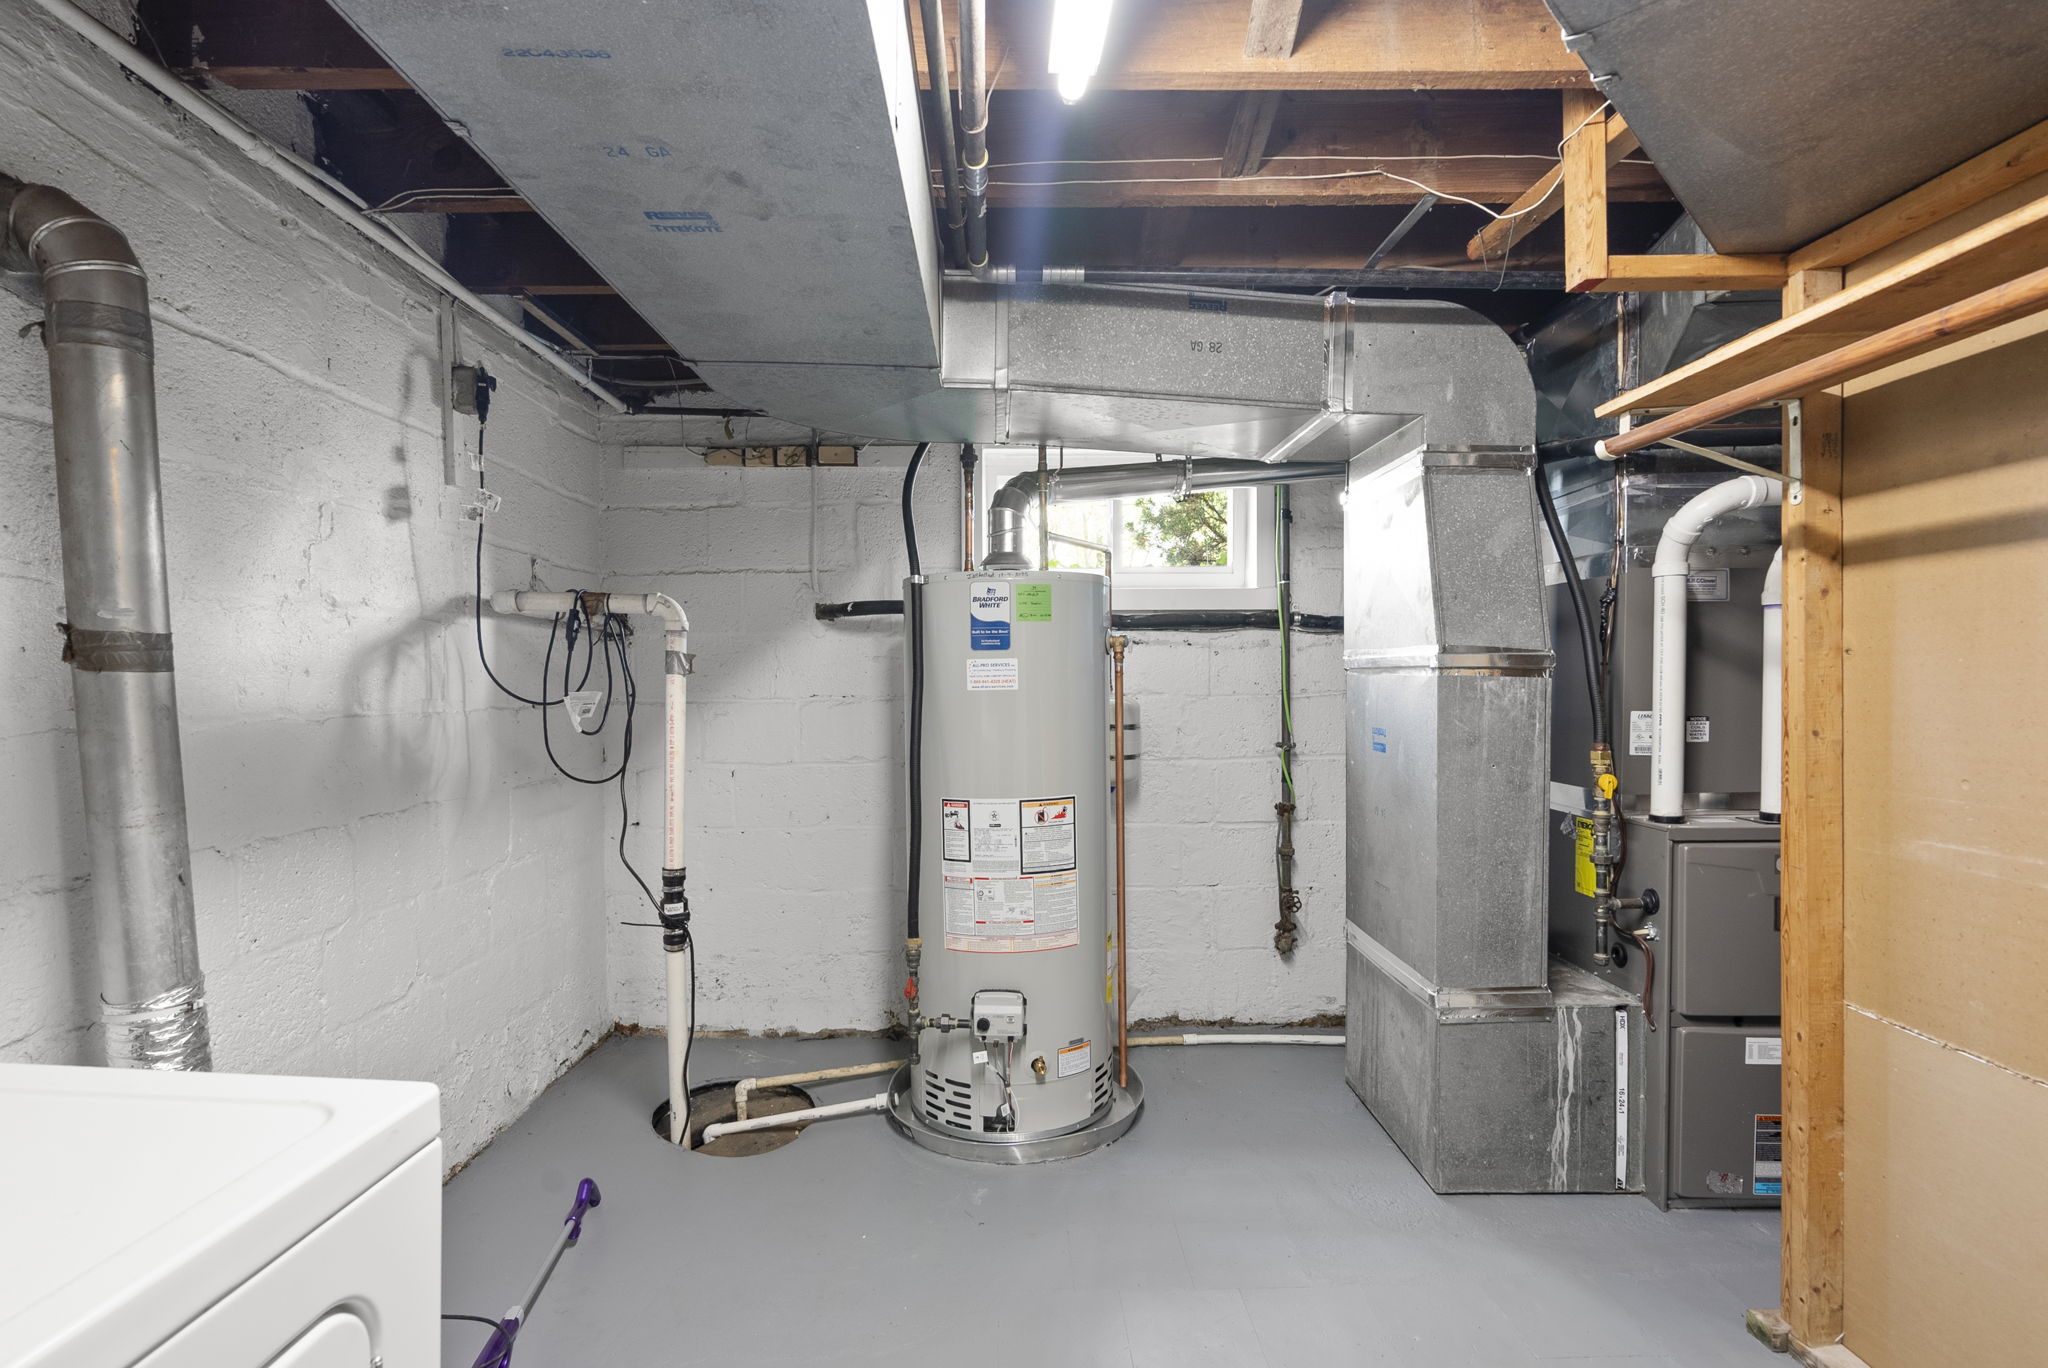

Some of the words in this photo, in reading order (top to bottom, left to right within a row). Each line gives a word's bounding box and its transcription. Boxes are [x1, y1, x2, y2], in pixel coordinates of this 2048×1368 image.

[603, 146, 629, 158] 24
[645, 146, 672, 158] GA
[1190, 340, 1204, 353] GA
[1208, 341, 1223, 354] 28
